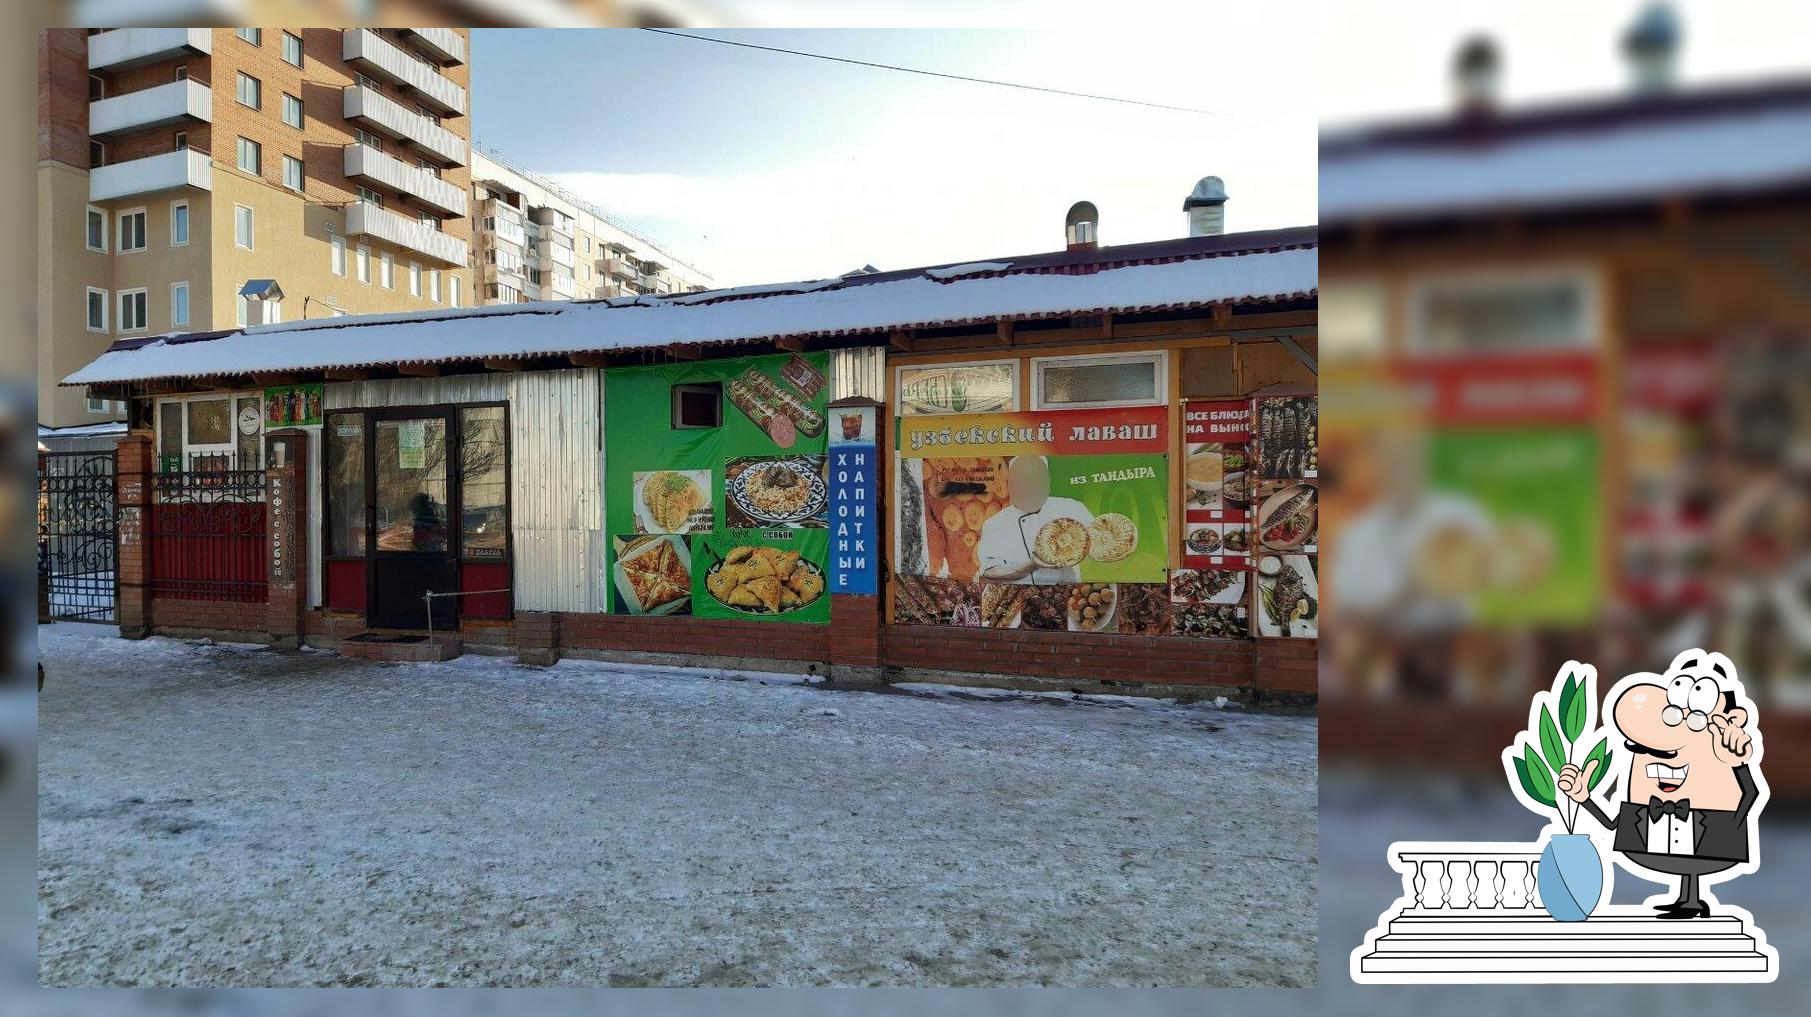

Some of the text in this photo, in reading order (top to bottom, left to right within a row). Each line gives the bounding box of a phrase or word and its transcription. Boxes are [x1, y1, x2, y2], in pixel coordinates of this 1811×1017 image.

[1186, 411, 1209, 421] ВСЕ
[910, 422, 1157, 450] узбекский лаваш
[1186, 424, 1204, 433] НА
[1069, 466, 1157, 485] из ТАНДЫРА
[273, 478, 283, 516] Кофе
[838, 454, 852, 586] ХОЛОДНЫЕ
[854, 453, 866, 569] НАПИТКИ
[769, 529, 793, 540] СОБОЙ
